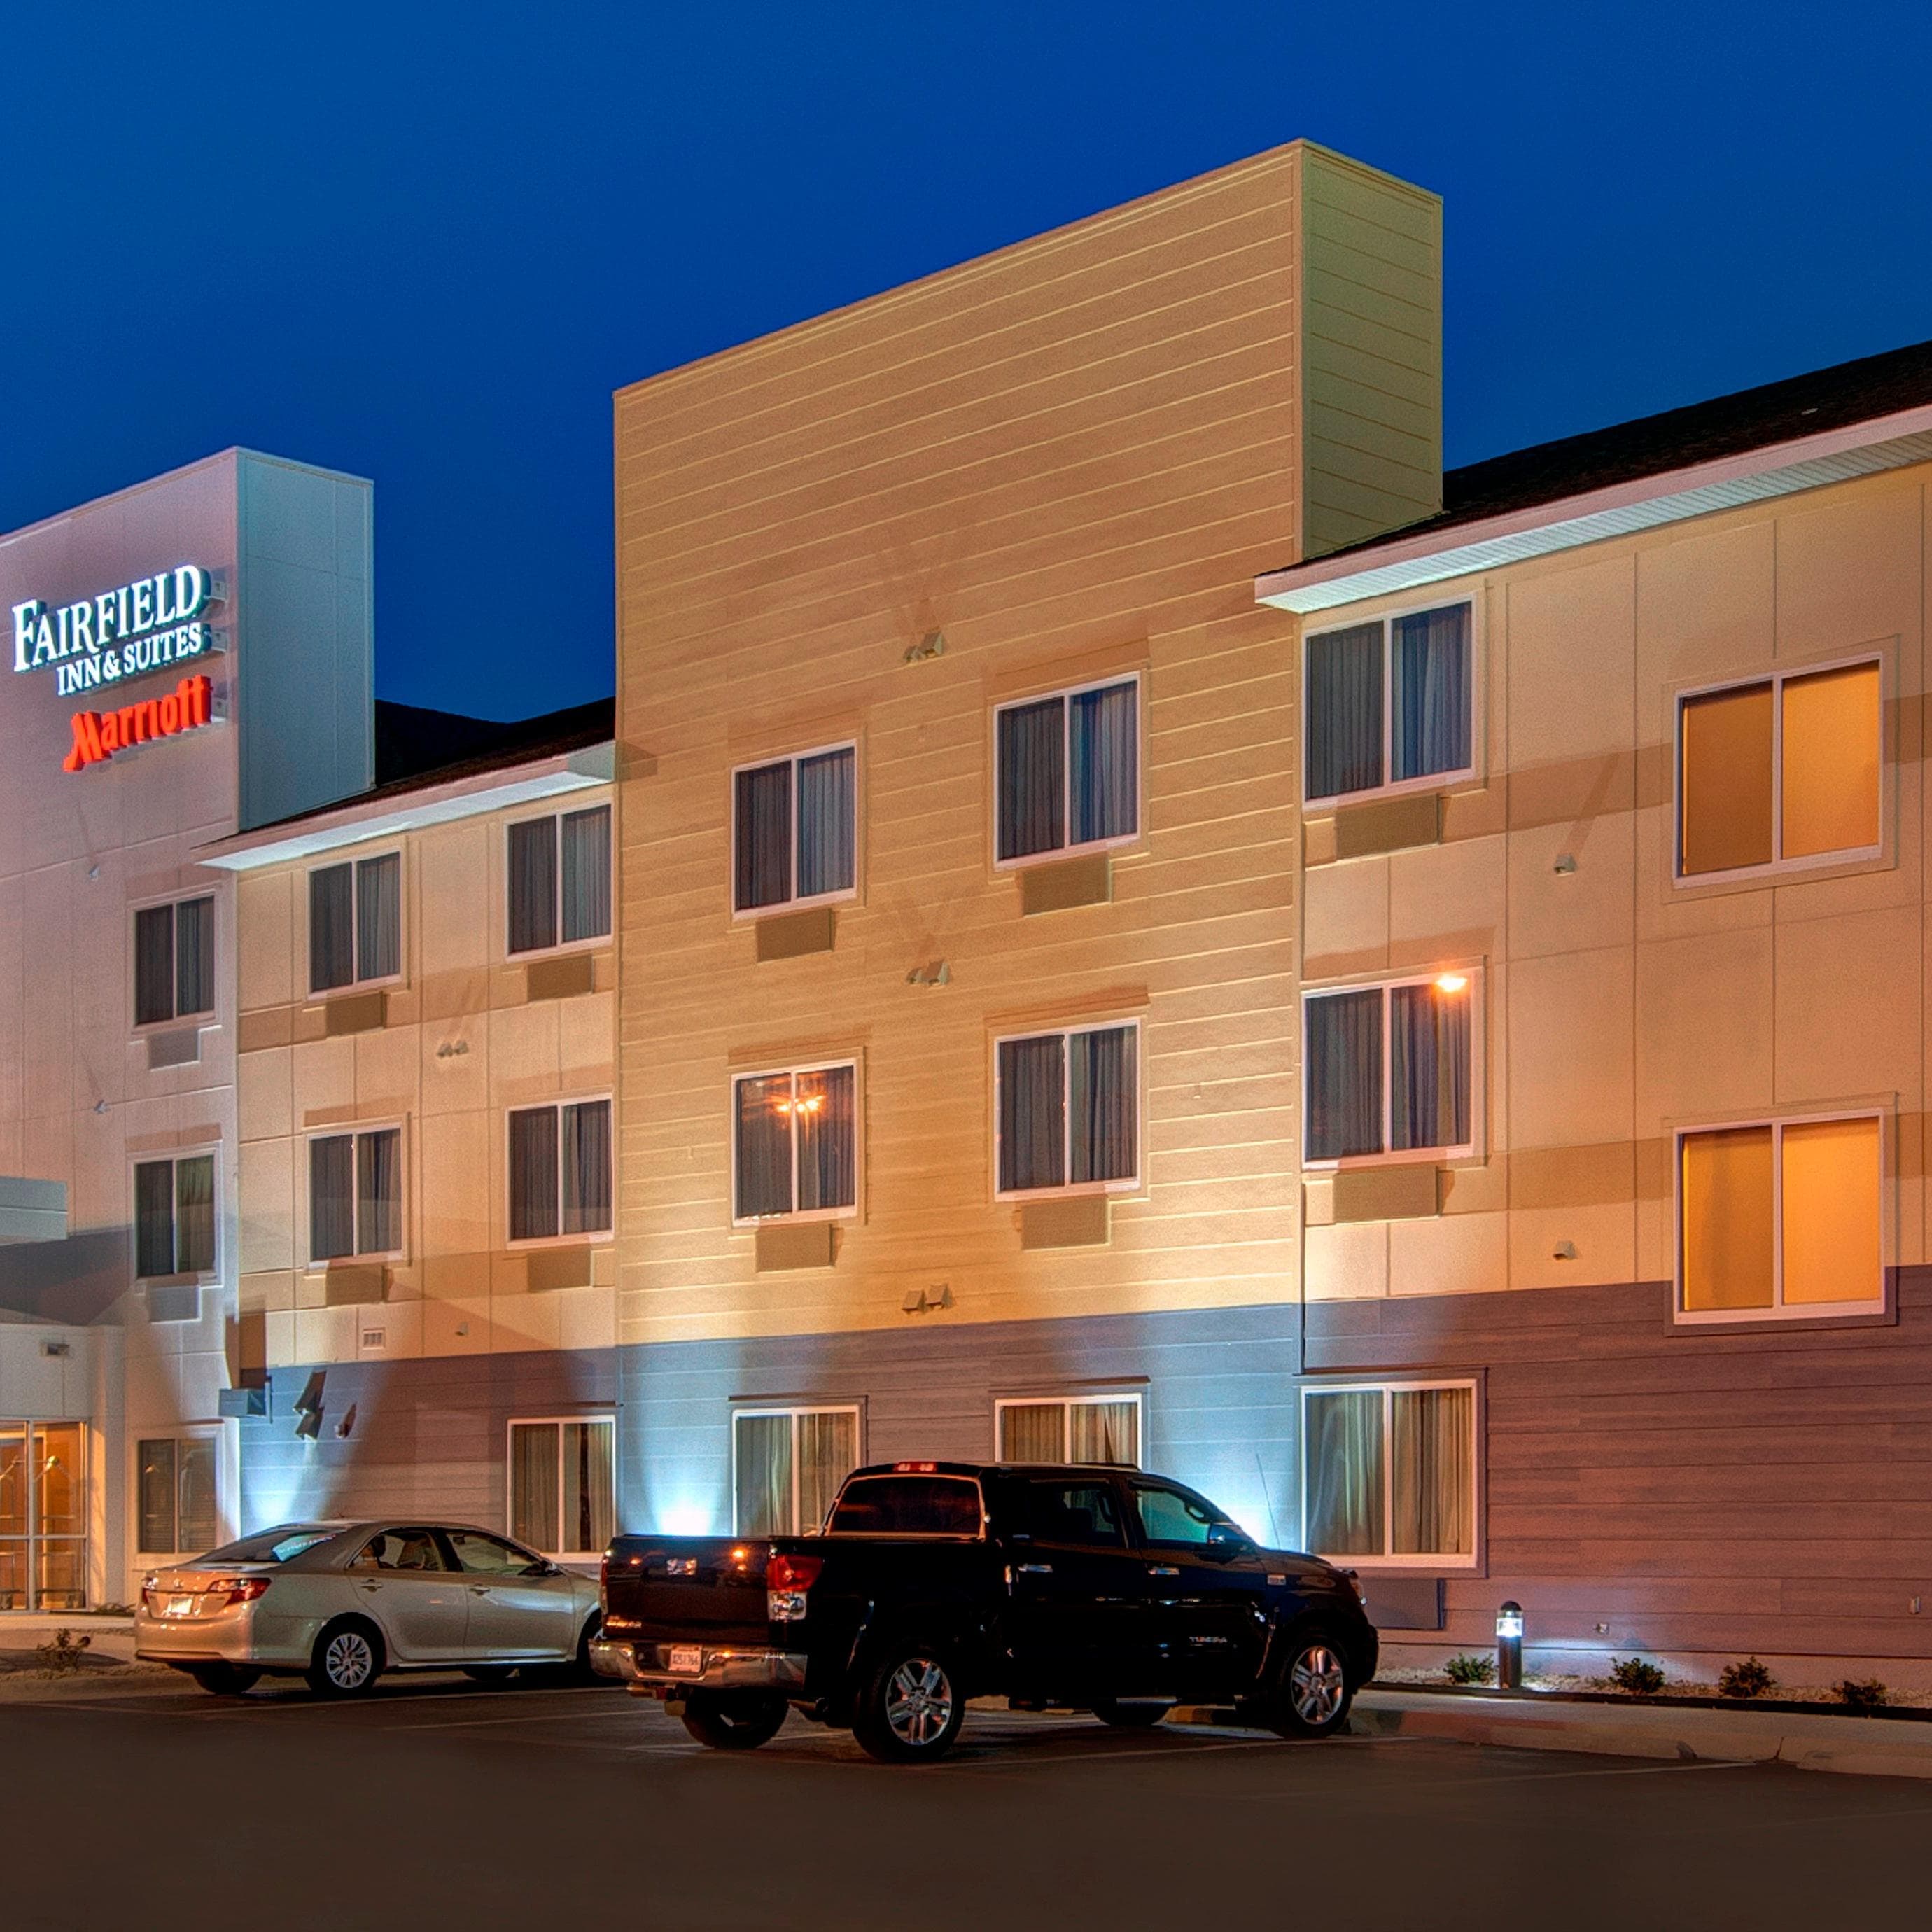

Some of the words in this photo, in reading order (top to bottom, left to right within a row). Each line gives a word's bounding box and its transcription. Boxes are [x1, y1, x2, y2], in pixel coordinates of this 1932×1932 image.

[12, 564, 204, 672] FAIRFIELD
[122, 622, 203, 674] SUITES
[62, 675, 209, 773] Marriott
